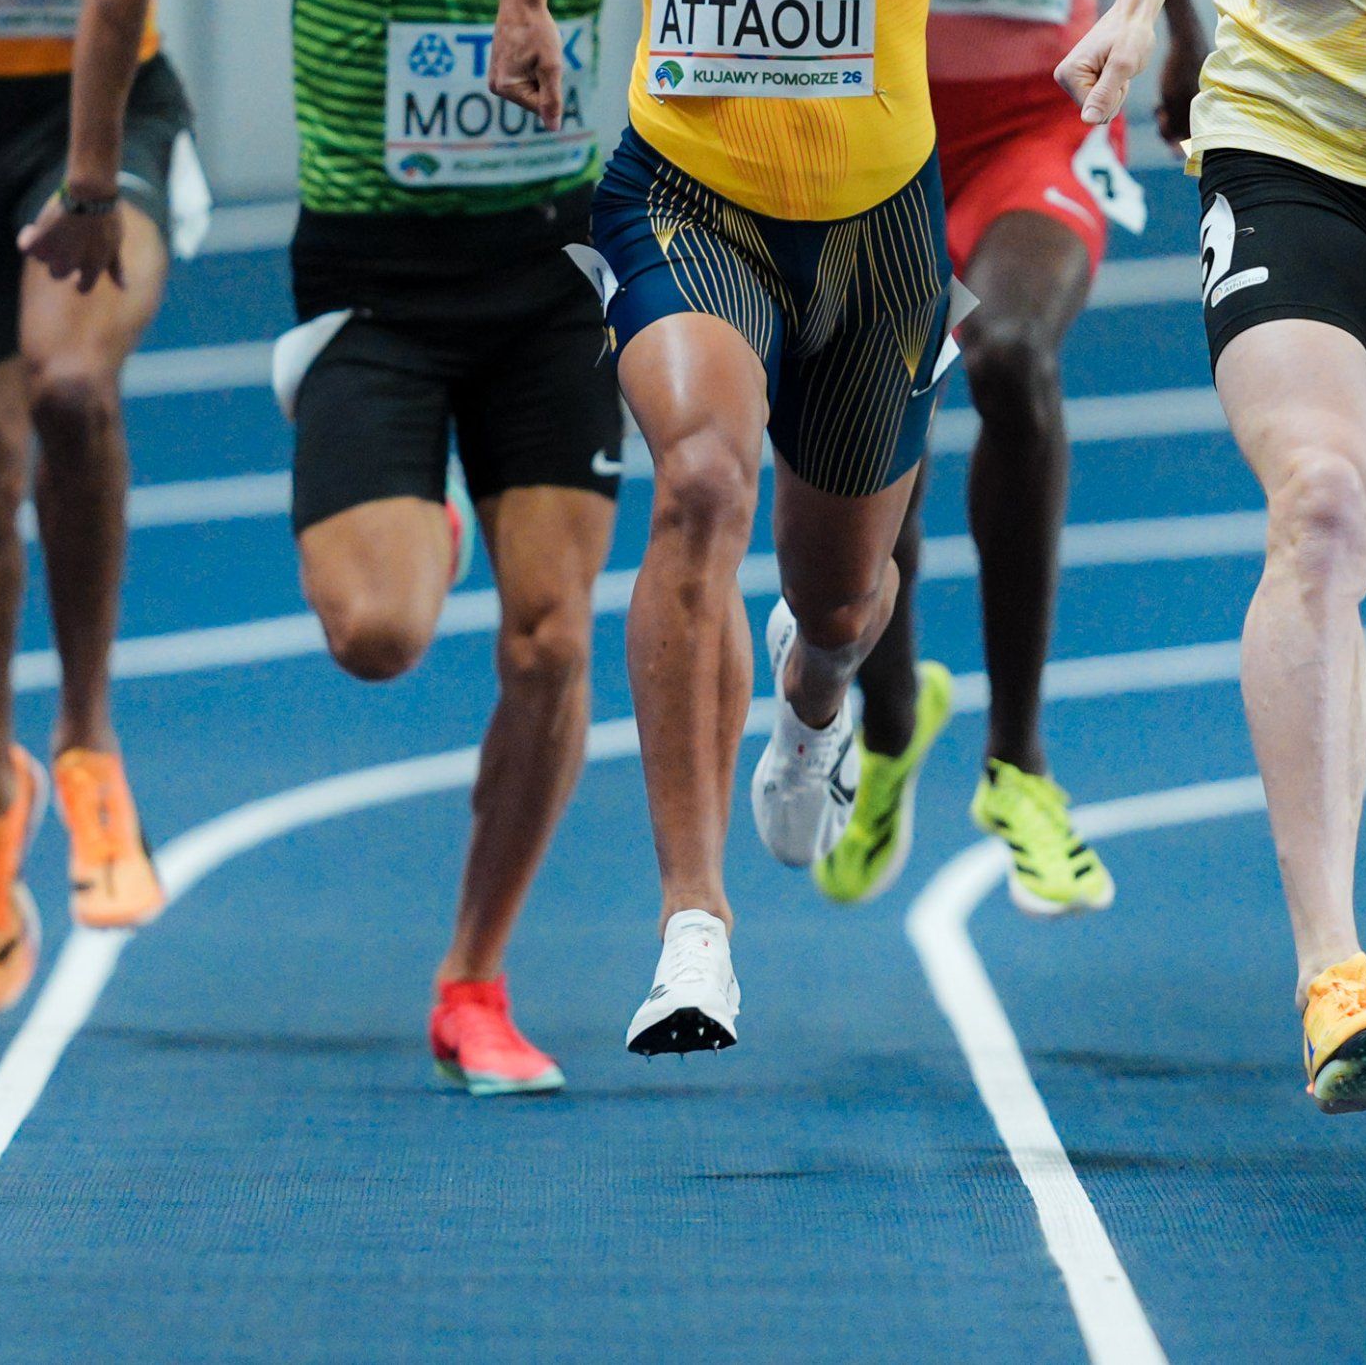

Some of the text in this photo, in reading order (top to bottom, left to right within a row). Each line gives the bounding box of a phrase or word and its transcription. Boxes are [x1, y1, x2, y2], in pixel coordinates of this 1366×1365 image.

[455, 28, 583, 77] TK
[693, 69, 862, 86] KUJAWY POMORZE 26
